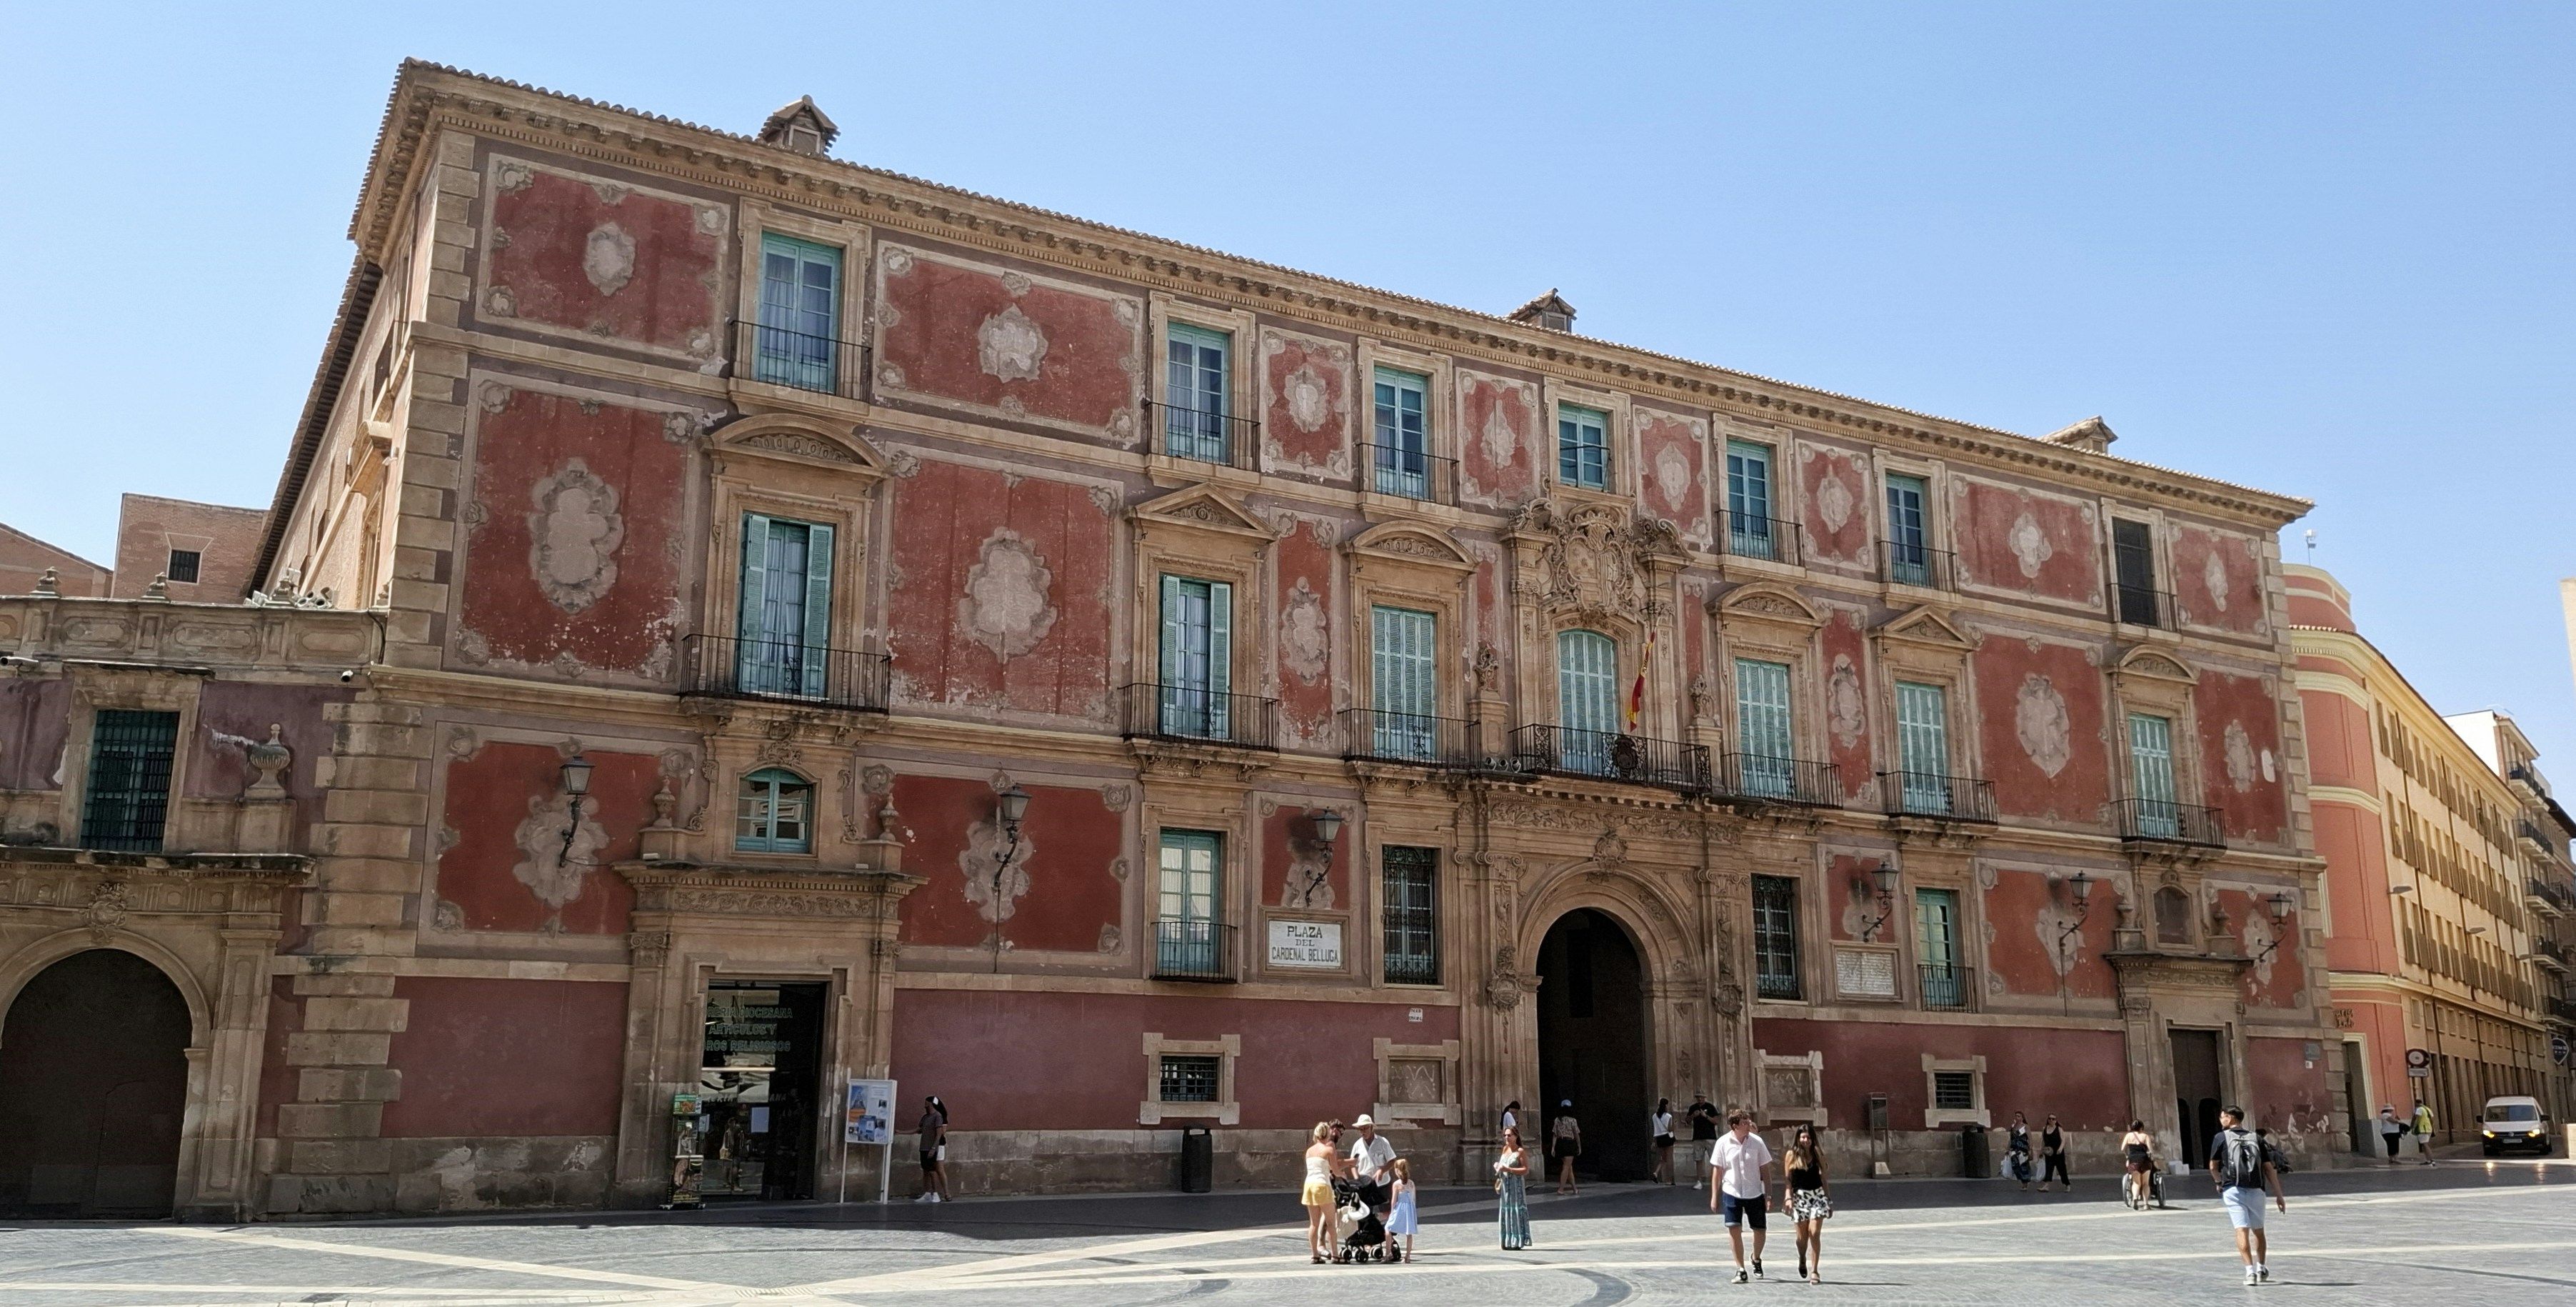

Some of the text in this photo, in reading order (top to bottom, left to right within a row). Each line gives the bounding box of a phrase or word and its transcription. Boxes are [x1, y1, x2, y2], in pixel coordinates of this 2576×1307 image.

[1287, 926, 1323, 938] PLAZA
[1272, 947, 1339, 963] CARDENAL BELLUGA
